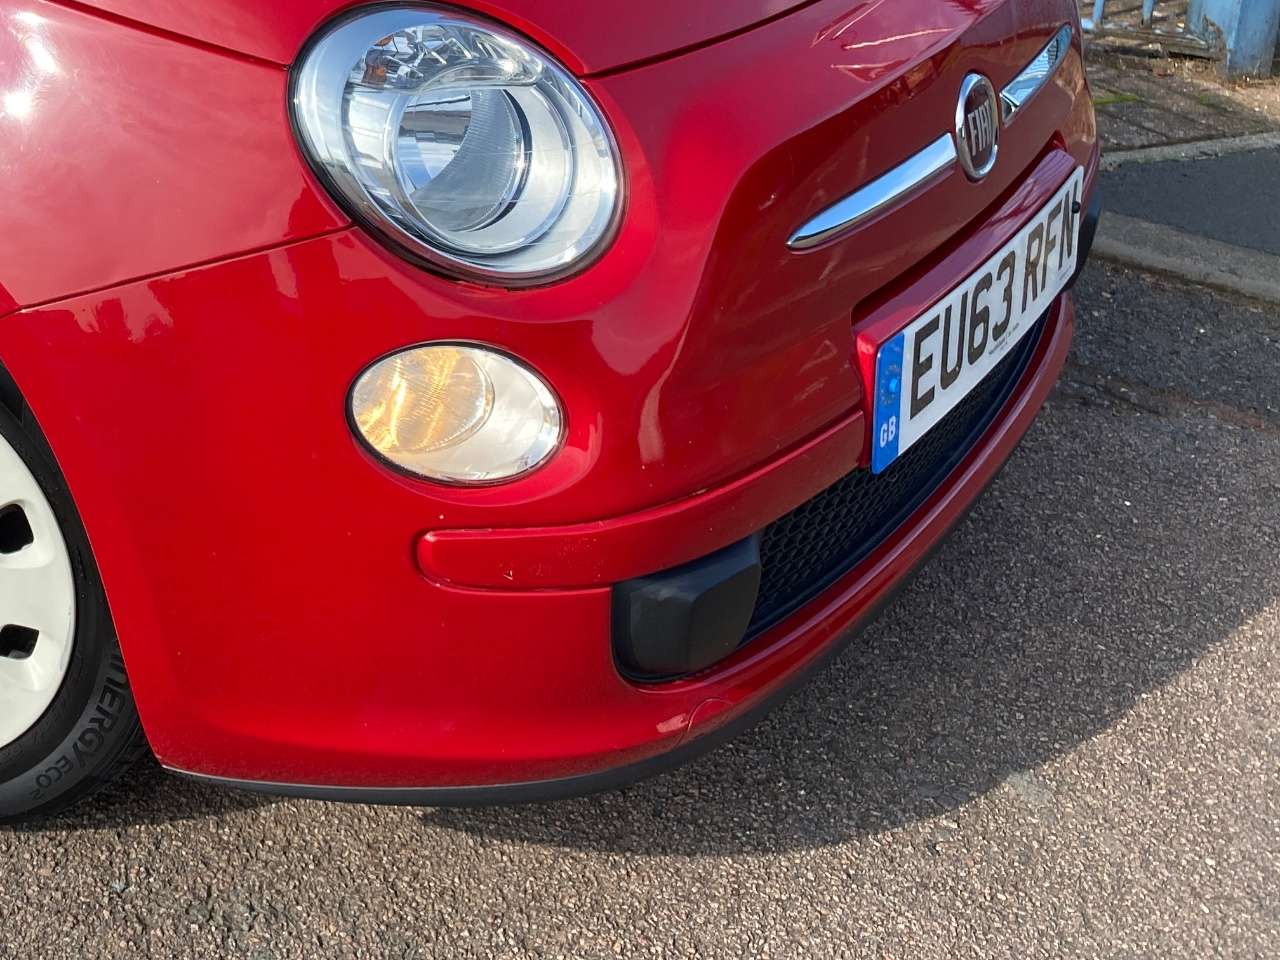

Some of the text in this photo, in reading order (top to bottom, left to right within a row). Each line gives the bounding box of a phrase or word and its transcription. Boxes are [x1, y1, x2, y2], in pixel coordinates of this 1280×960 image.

[967, 98, 994, 157] FIAT
[910, 180, 1078, 420] EU63 RFN
[879, 415, 896, 448] GB
